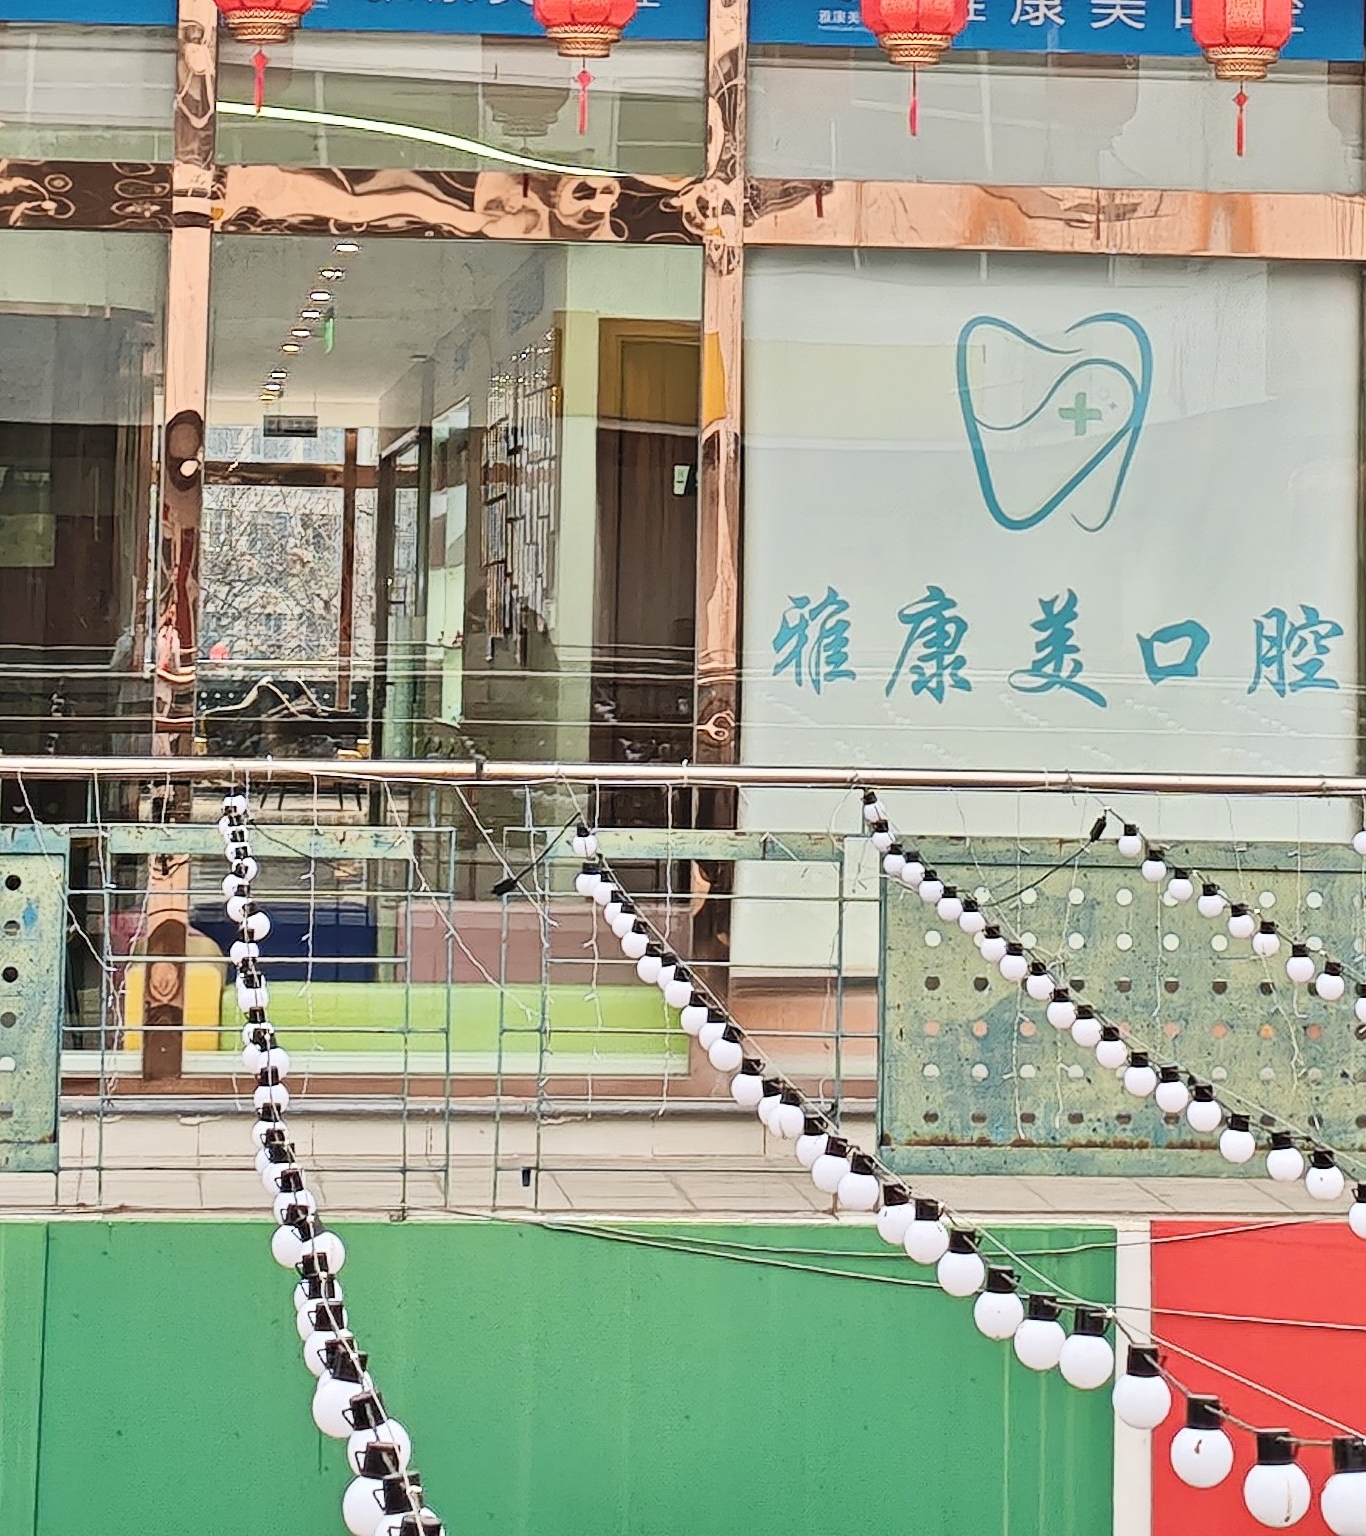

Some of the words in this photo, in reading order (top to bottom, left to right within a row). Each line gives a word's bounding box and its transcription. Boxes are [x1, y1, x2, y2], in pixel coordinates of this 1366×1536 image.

[771, 585, 1346, 709] 雅康美口腔
